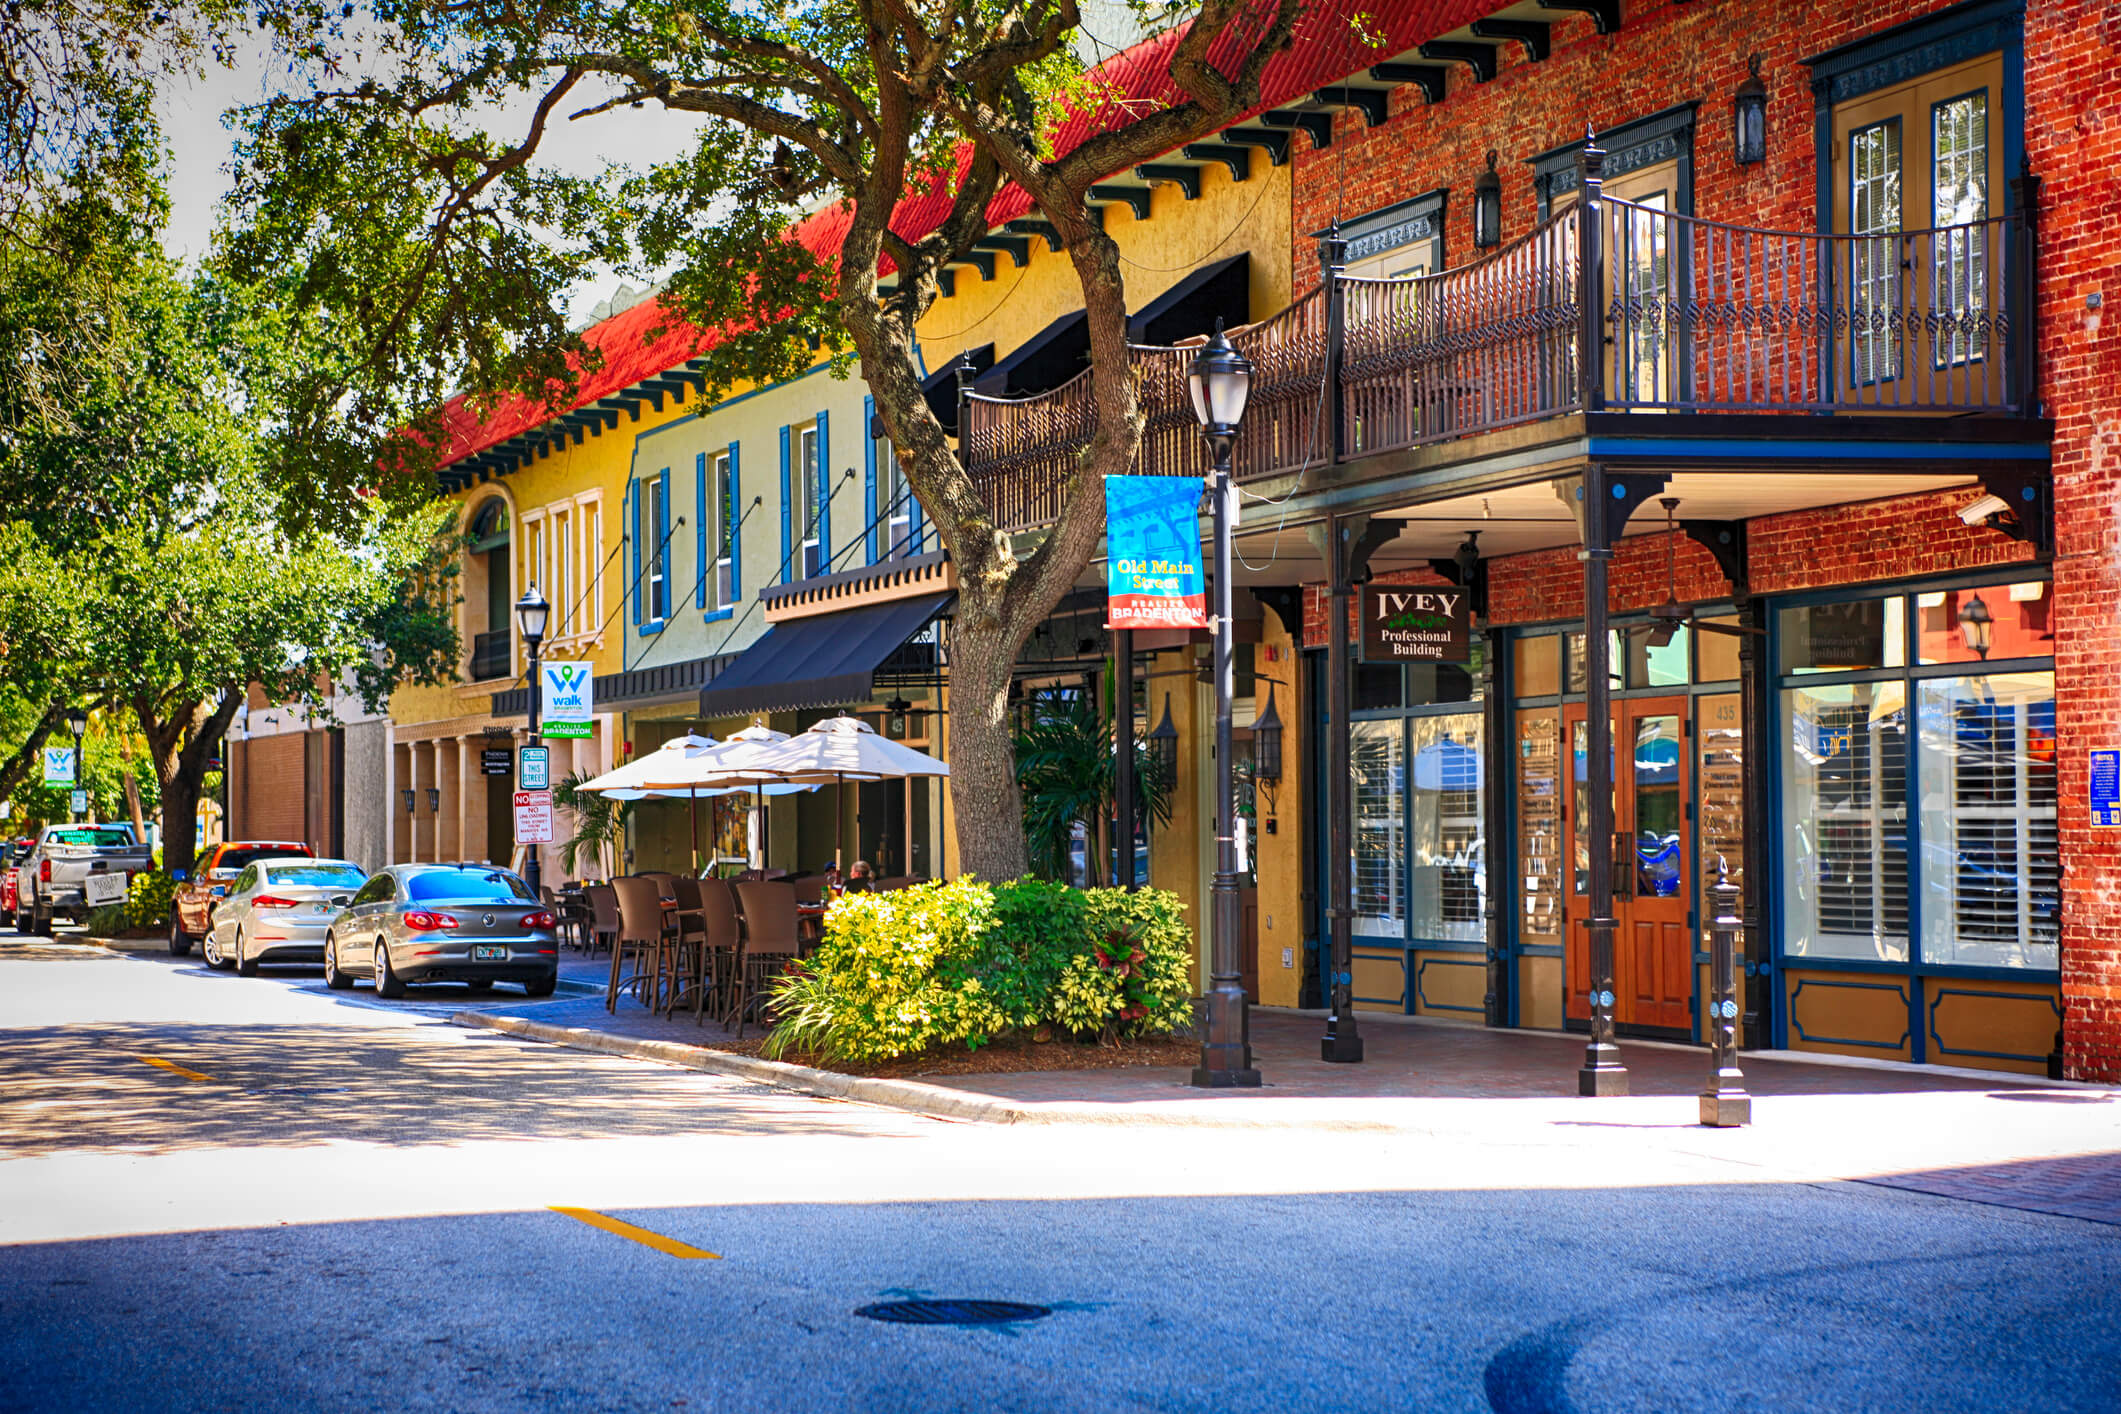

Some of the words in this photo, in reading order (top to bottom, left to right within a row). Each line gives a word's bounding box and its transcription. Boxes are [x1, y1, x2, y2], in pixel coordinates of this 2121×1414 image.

[1118, 560, 1147, 574] Old
[1151, 560, 1194, 574] Main
[1133, 575, 1179, 589] Street
[1376, 593, 1461, 620] IVEY
[1112, 608, 1202, 619] BRADENTON
[1381, 630, 1451, 642] Professional
[1393, 643, 1443, 658] Building
[553, 695, 582, 706] walk
[1716, 704, 1736, 720] 435
[528, 764, 541, 773] THIS
[523, 774, 545, 783] STREET
[516, 795, 529, 804] NO
